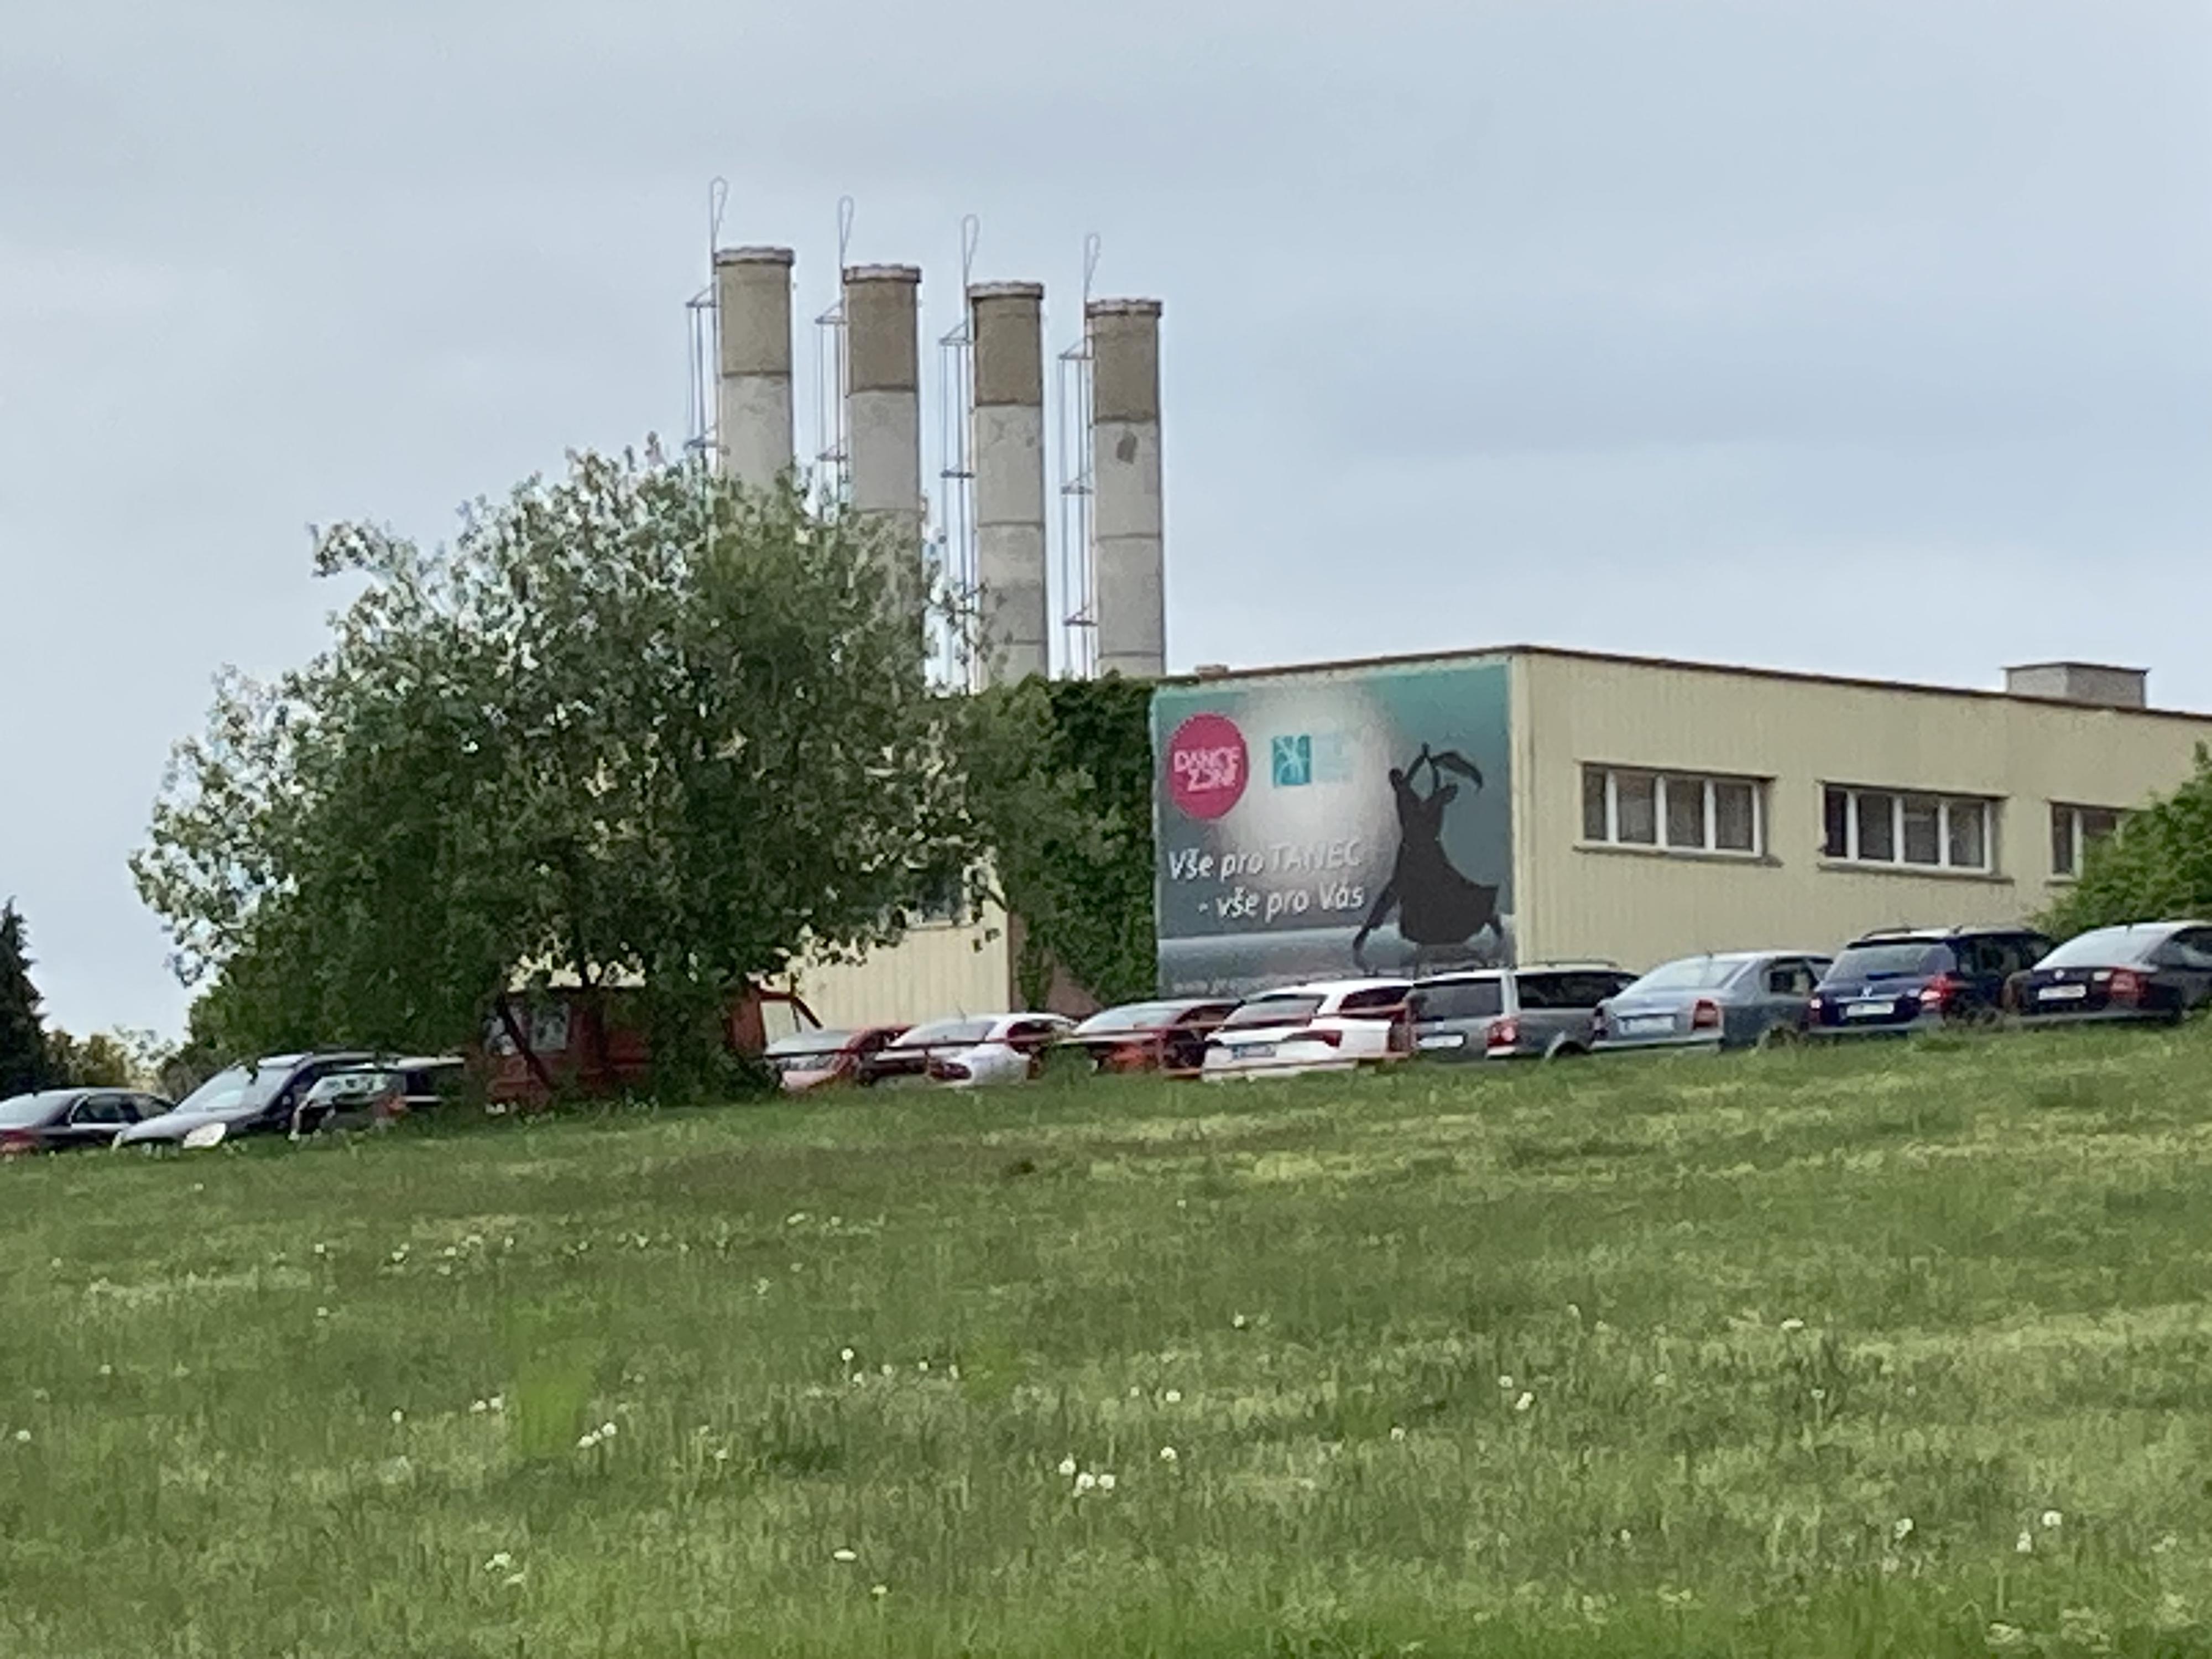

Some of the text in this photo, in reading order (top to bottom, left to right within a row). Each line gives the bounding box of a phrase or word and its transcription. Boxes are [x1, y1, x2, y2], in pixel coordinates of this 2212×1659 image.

[1220, 853, 1264, 883] pro
[1269, 839, 1362, 873] TANEC
[1216, 886, 1261, 918] vše
[1264, 889, 1310, 923] pro
[1319, 877, 1364, 910] Vás
